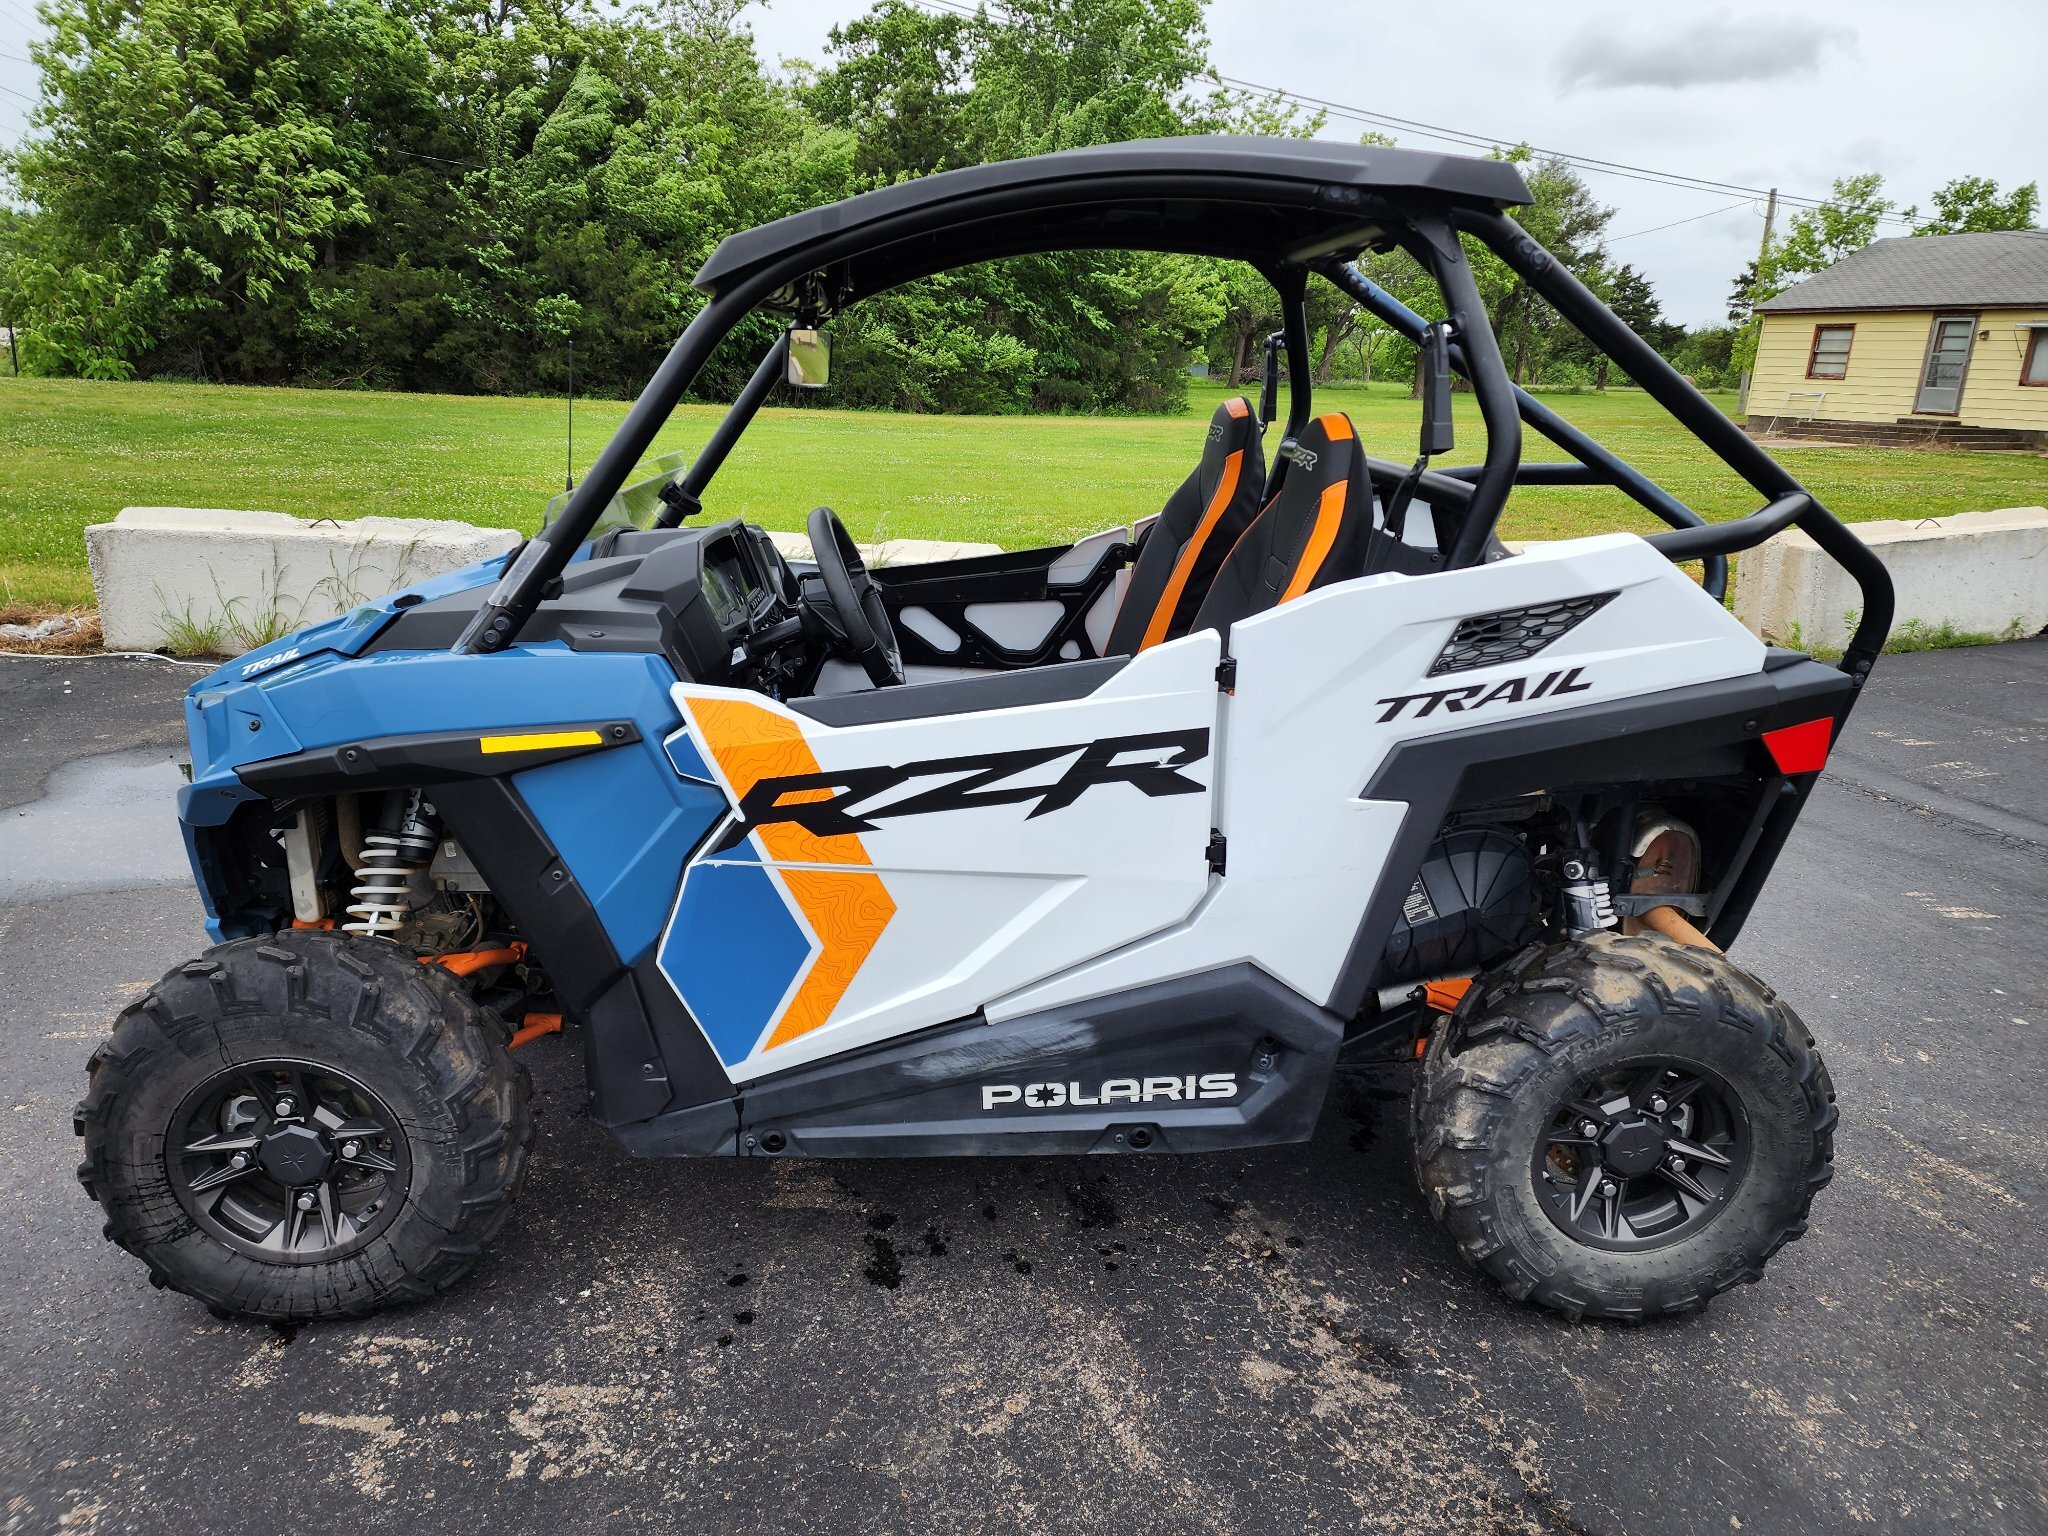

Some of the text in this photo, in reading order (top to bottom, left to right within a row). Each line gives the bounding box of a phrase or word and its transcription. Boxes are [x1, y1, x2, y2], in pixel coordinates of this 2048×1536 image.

[1292, 445, 1318, 472] ZR
[241, 647, 300, 676] TRAIL
[1375, 666, 1593, 724] TRAIL
[713, 726, 1210, 854] RZR
[981, 1072, 1238, 1111] POLARIS
